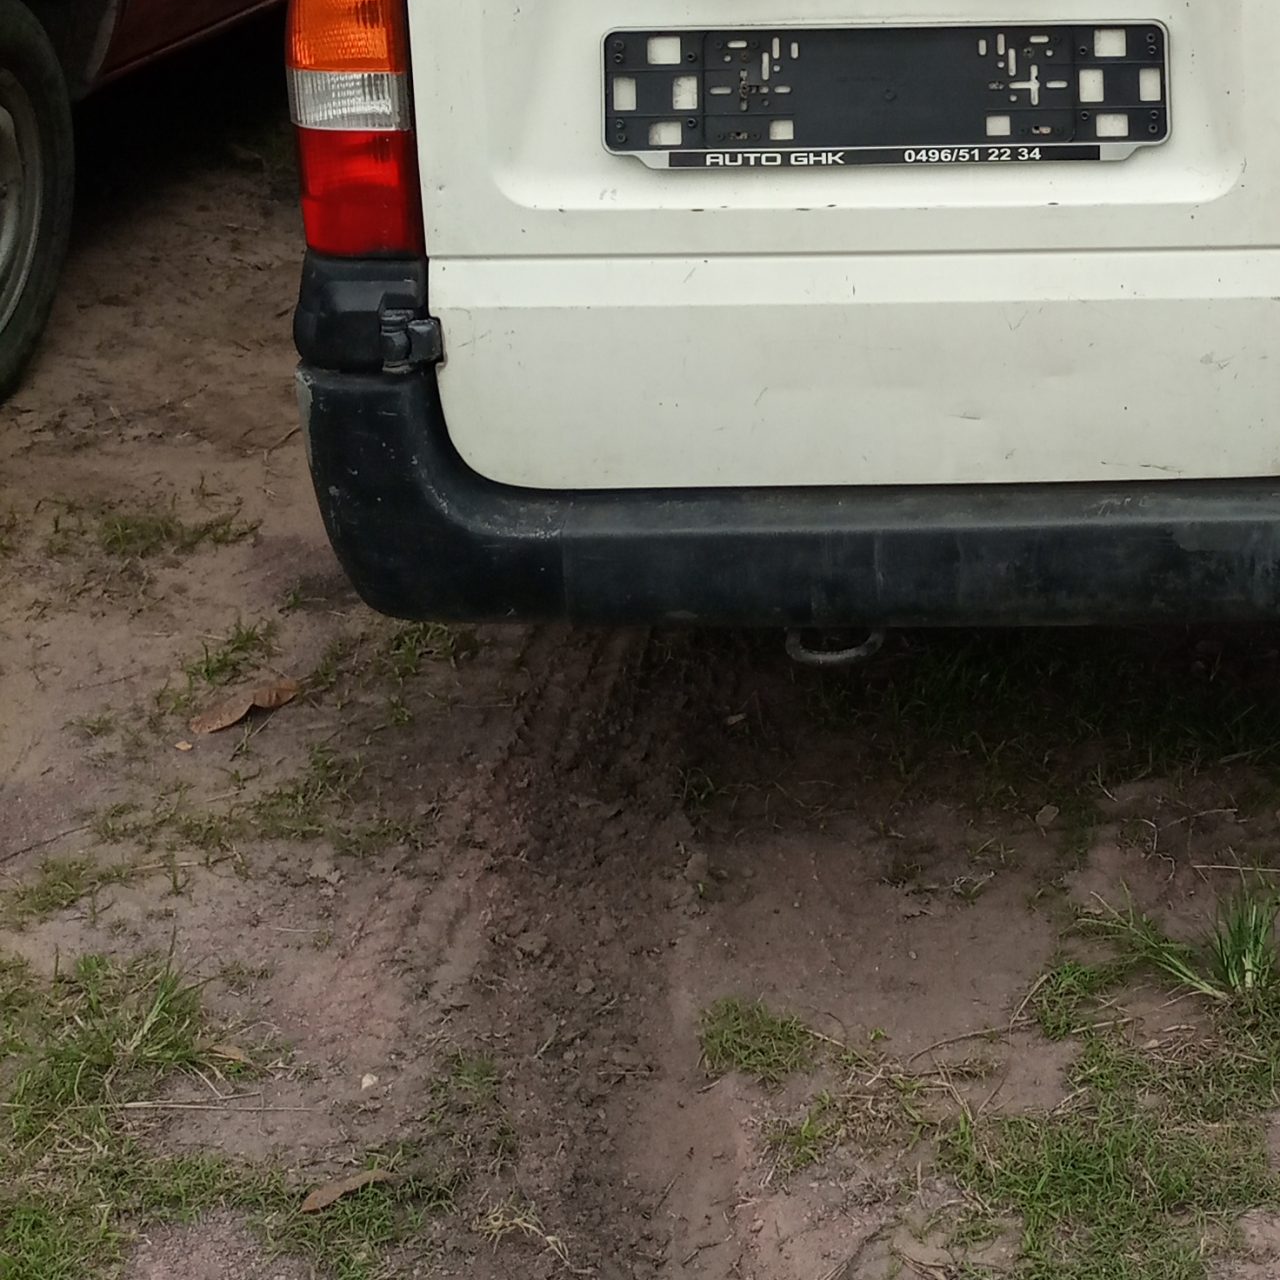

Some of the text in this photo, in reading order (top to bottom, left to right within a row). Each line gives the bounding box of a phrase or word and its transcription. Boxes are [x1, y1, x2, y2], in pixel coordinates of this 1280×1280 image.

[706, 147, 1042, 166] AUTO GHK 0496/51 22 34
